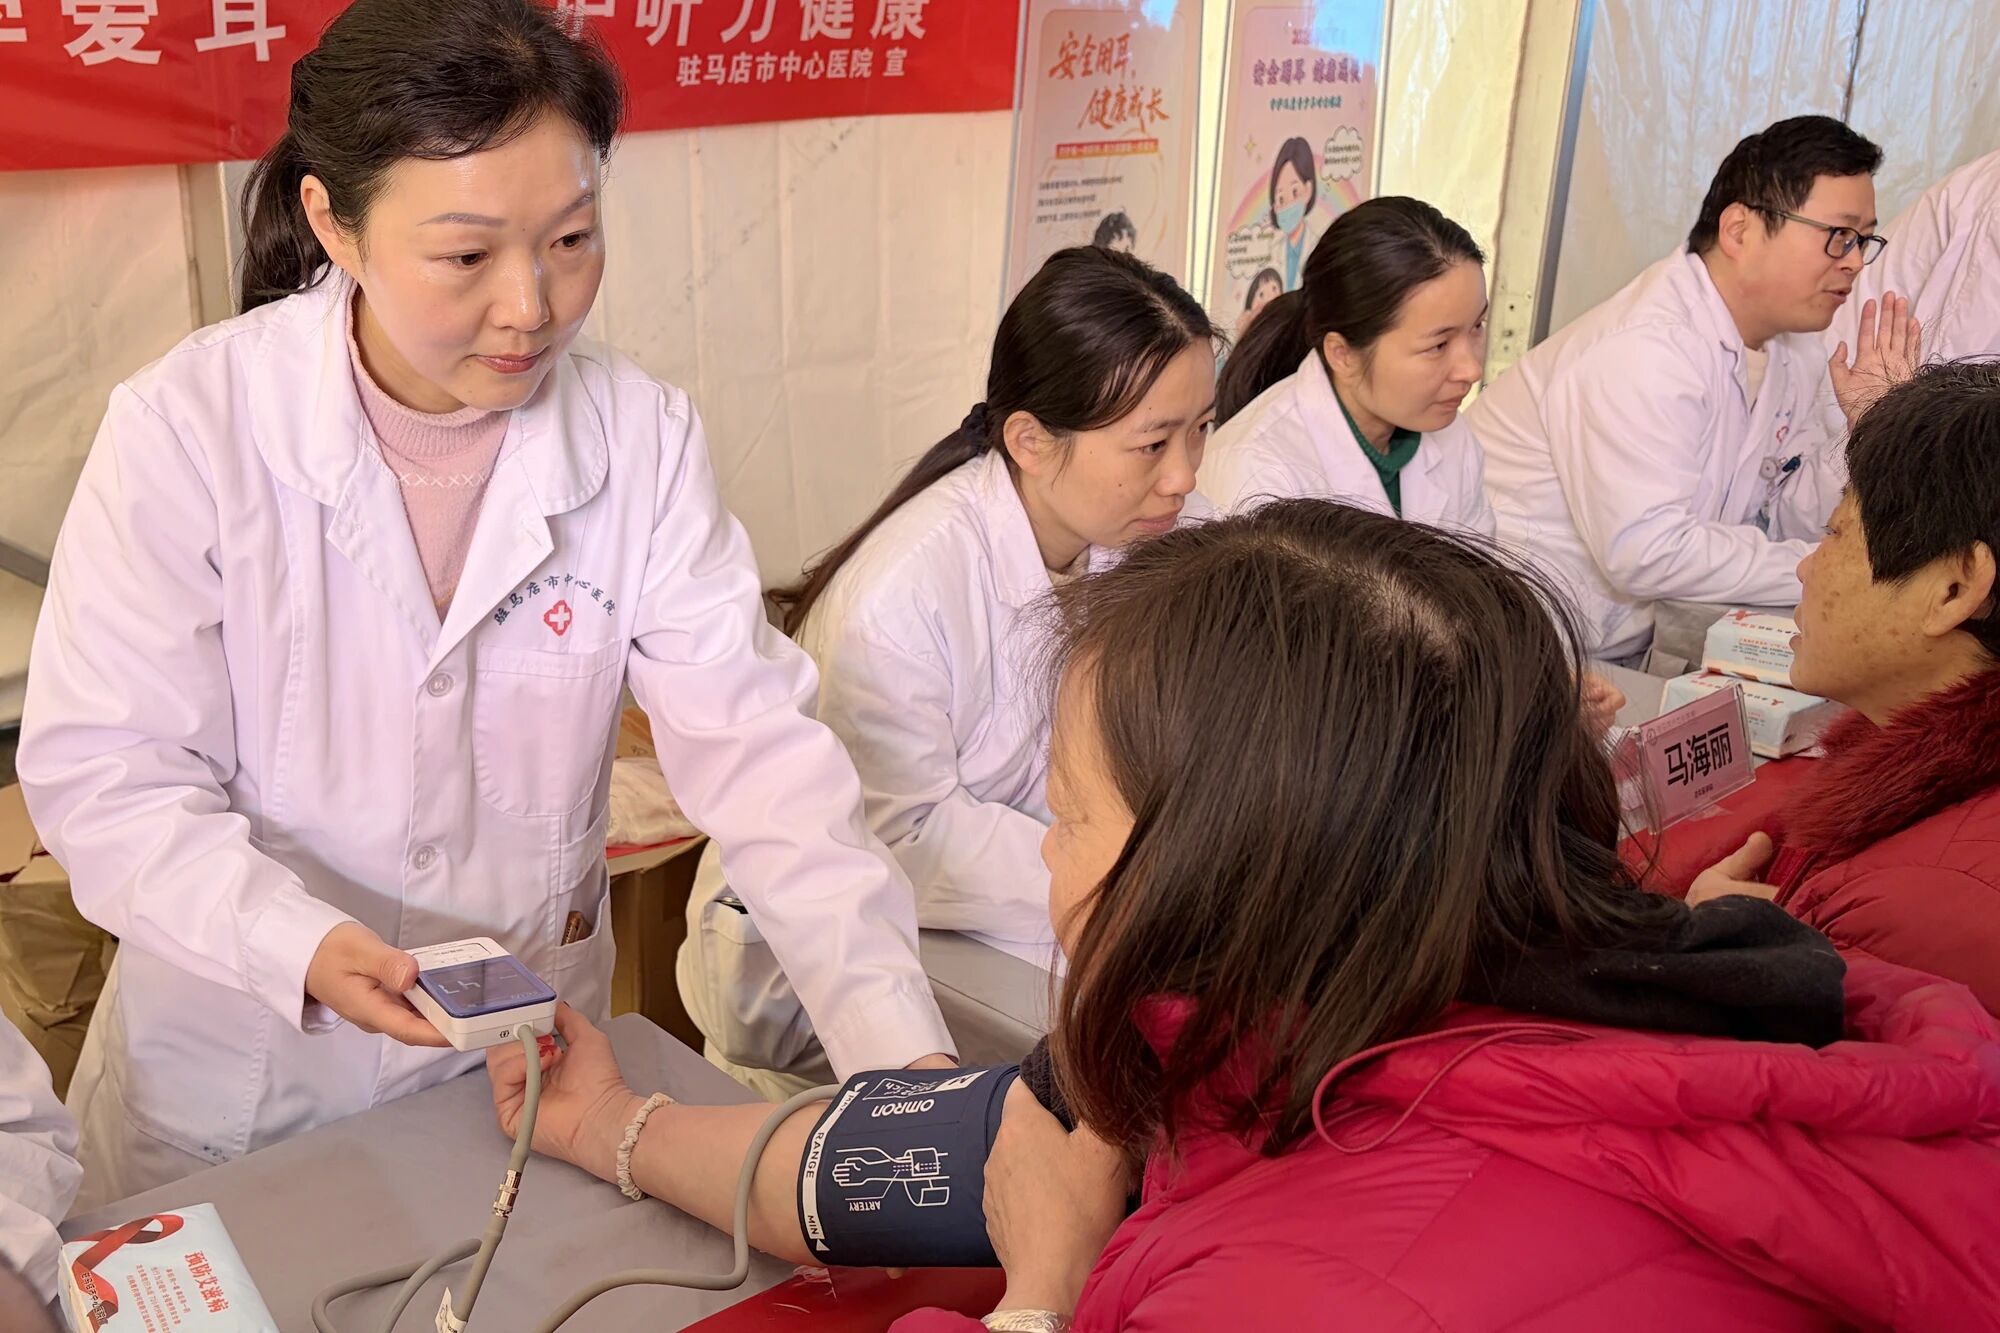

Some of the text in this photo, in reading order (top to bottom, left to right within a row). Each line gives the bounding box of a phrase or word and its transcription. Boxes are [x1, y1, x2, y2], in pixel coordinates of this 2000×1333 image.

[676, 47, 908, 87] 驻马店市中心医院 宣
[1078, 84, 1169, 132] 健康成长
[493, 573, 616, 625] 驻马店市中心医院
[1664, 722, 1733, 787] 马海丽
[871, 1099, 935, 1118] OMRON
[805, 1132, 825, 1179] RANGE
[807, 1214, 820, 1236] MIN
[849, 1200, 881, 1212] ARTERY
[184, 1250, 229, 1313] 预防艾滋病
